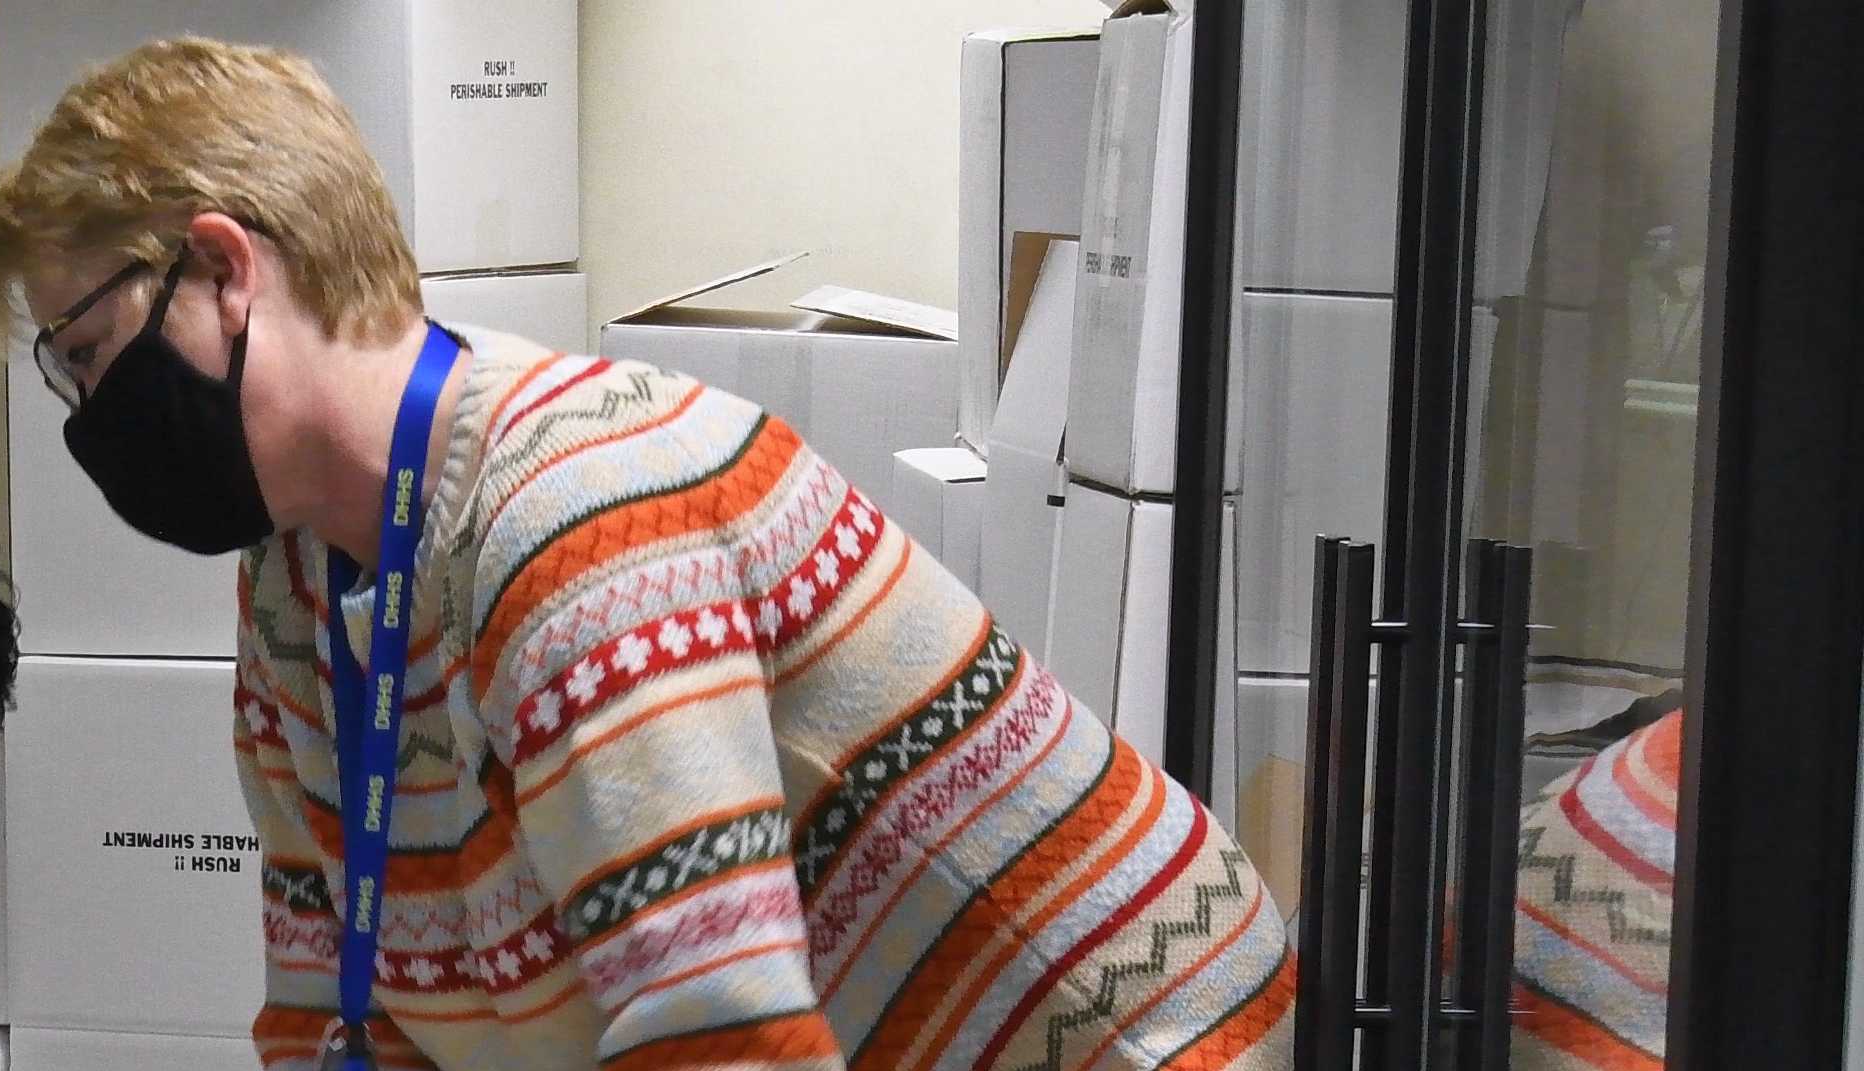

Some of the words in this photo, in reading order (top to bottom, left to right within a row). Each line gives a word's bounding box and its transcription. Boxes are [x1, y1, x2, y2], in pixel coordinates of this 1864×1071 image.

[484, 61, 507, 76] RUSH
[450, 83, 503, 99] PERISHABLE
[505, 82, 548, 98] SHIPMENT
[102, 831, 194, 849] SHIPMENT
[201, 834, 259, 851] HABLE
[192, 856, 241, 872] RUSH
